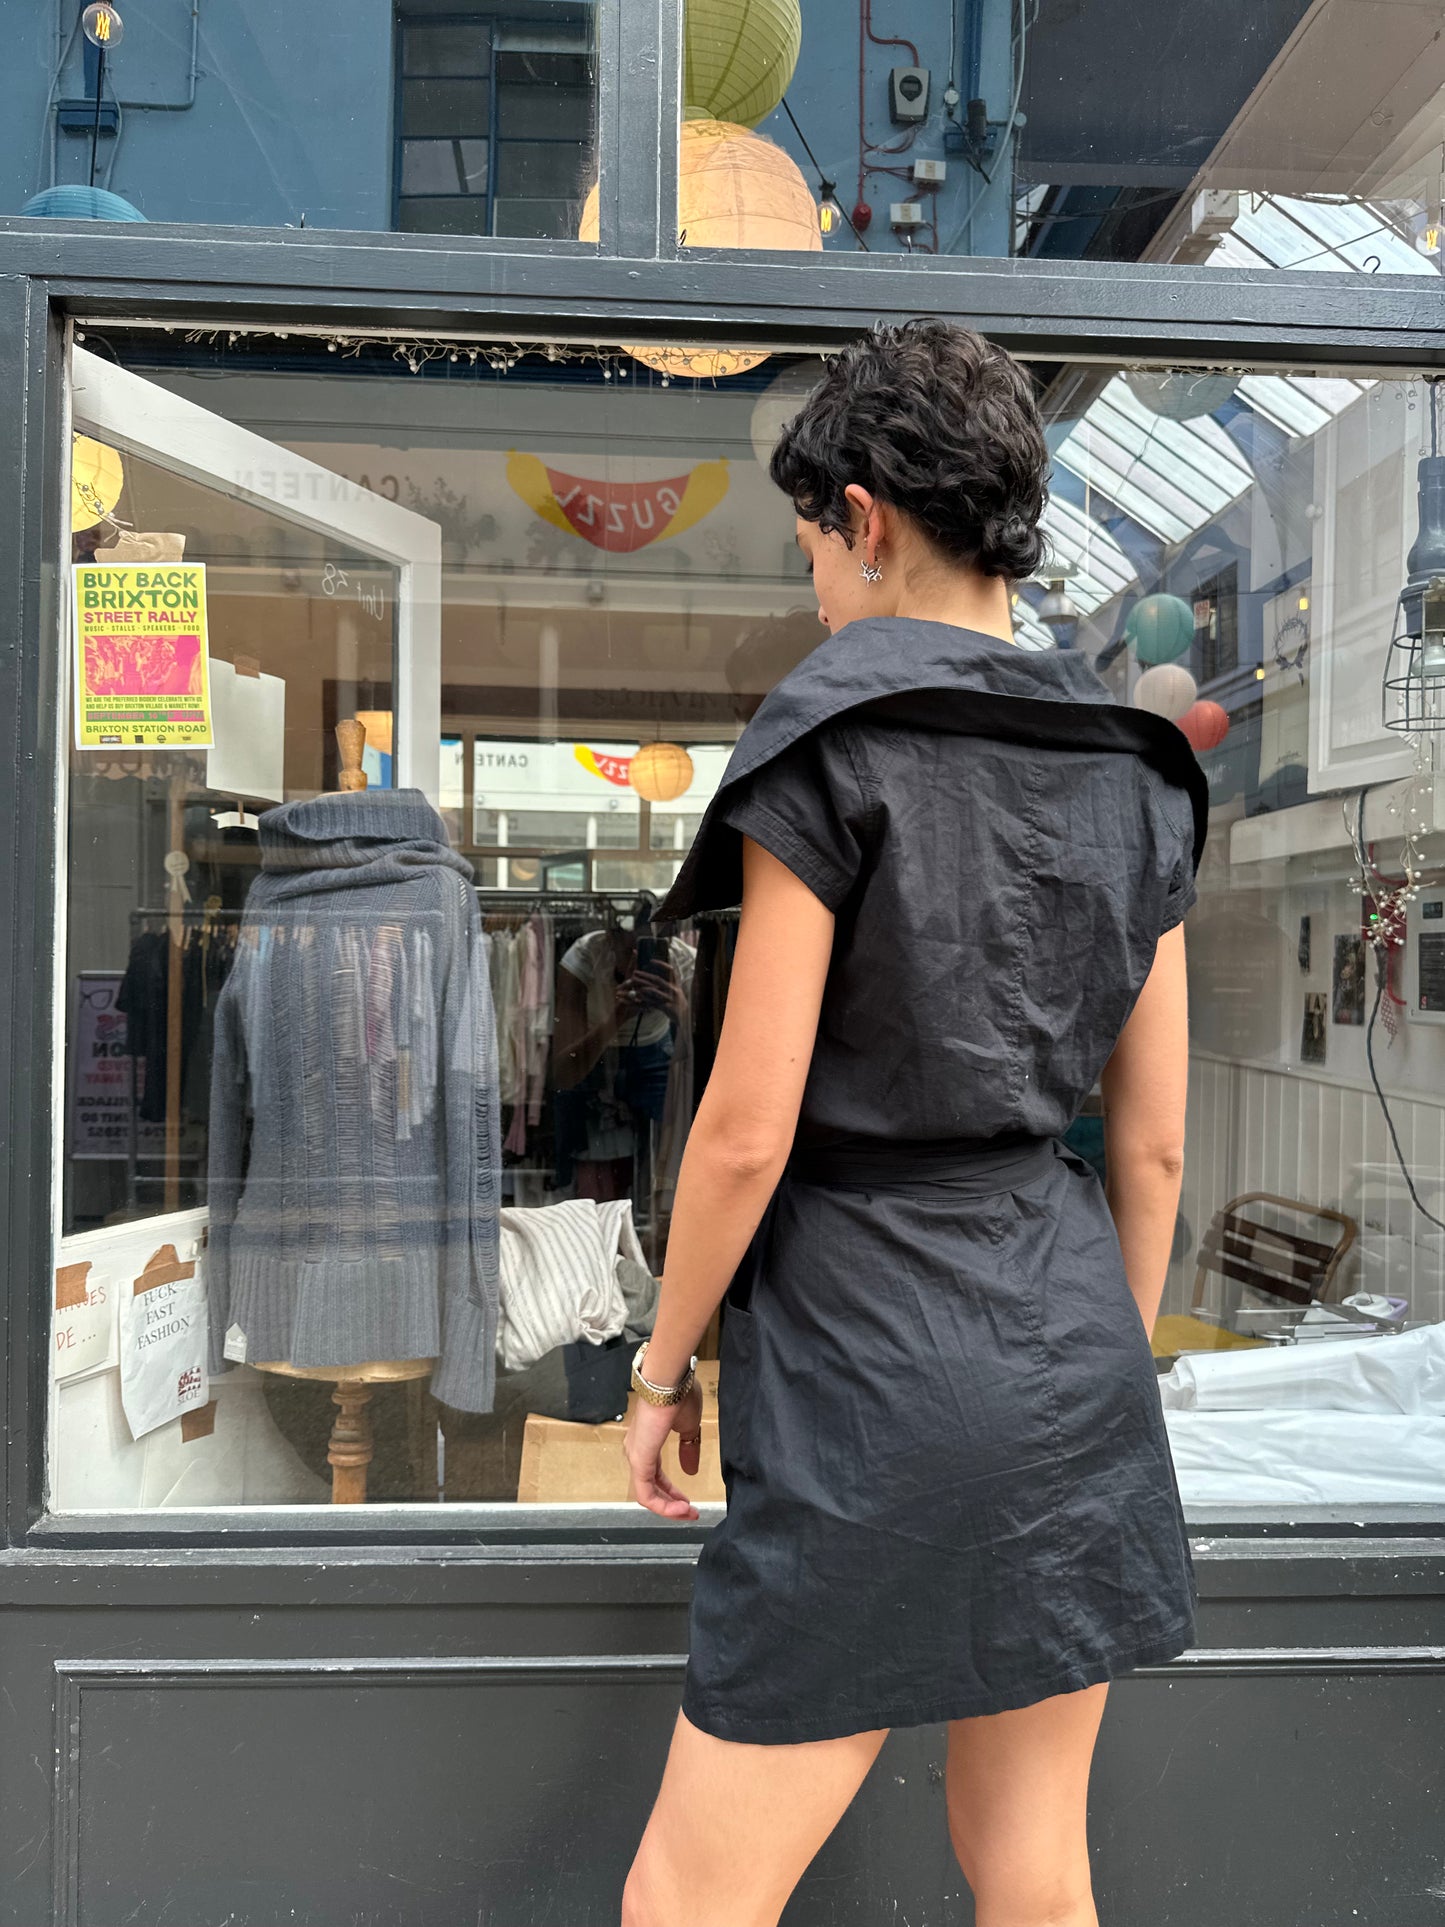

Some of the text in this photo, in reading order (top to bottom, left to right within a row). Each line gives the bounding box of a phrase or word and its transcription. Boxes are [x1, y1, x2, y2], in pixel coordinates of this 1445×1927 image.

[84, 572, 197, 588] BUY BACK
[84, 589, 199, 609] BRIXTON
[84, 611, 197, 624] STREET RALLY
[86, 724, 207, 733] BRIXTON STATION ROAD
[144, 1283, 178, 1306] FUCK
[146, 1302, 175, 1325] FAST
[137, 1315, 191, 1350] FASHION
